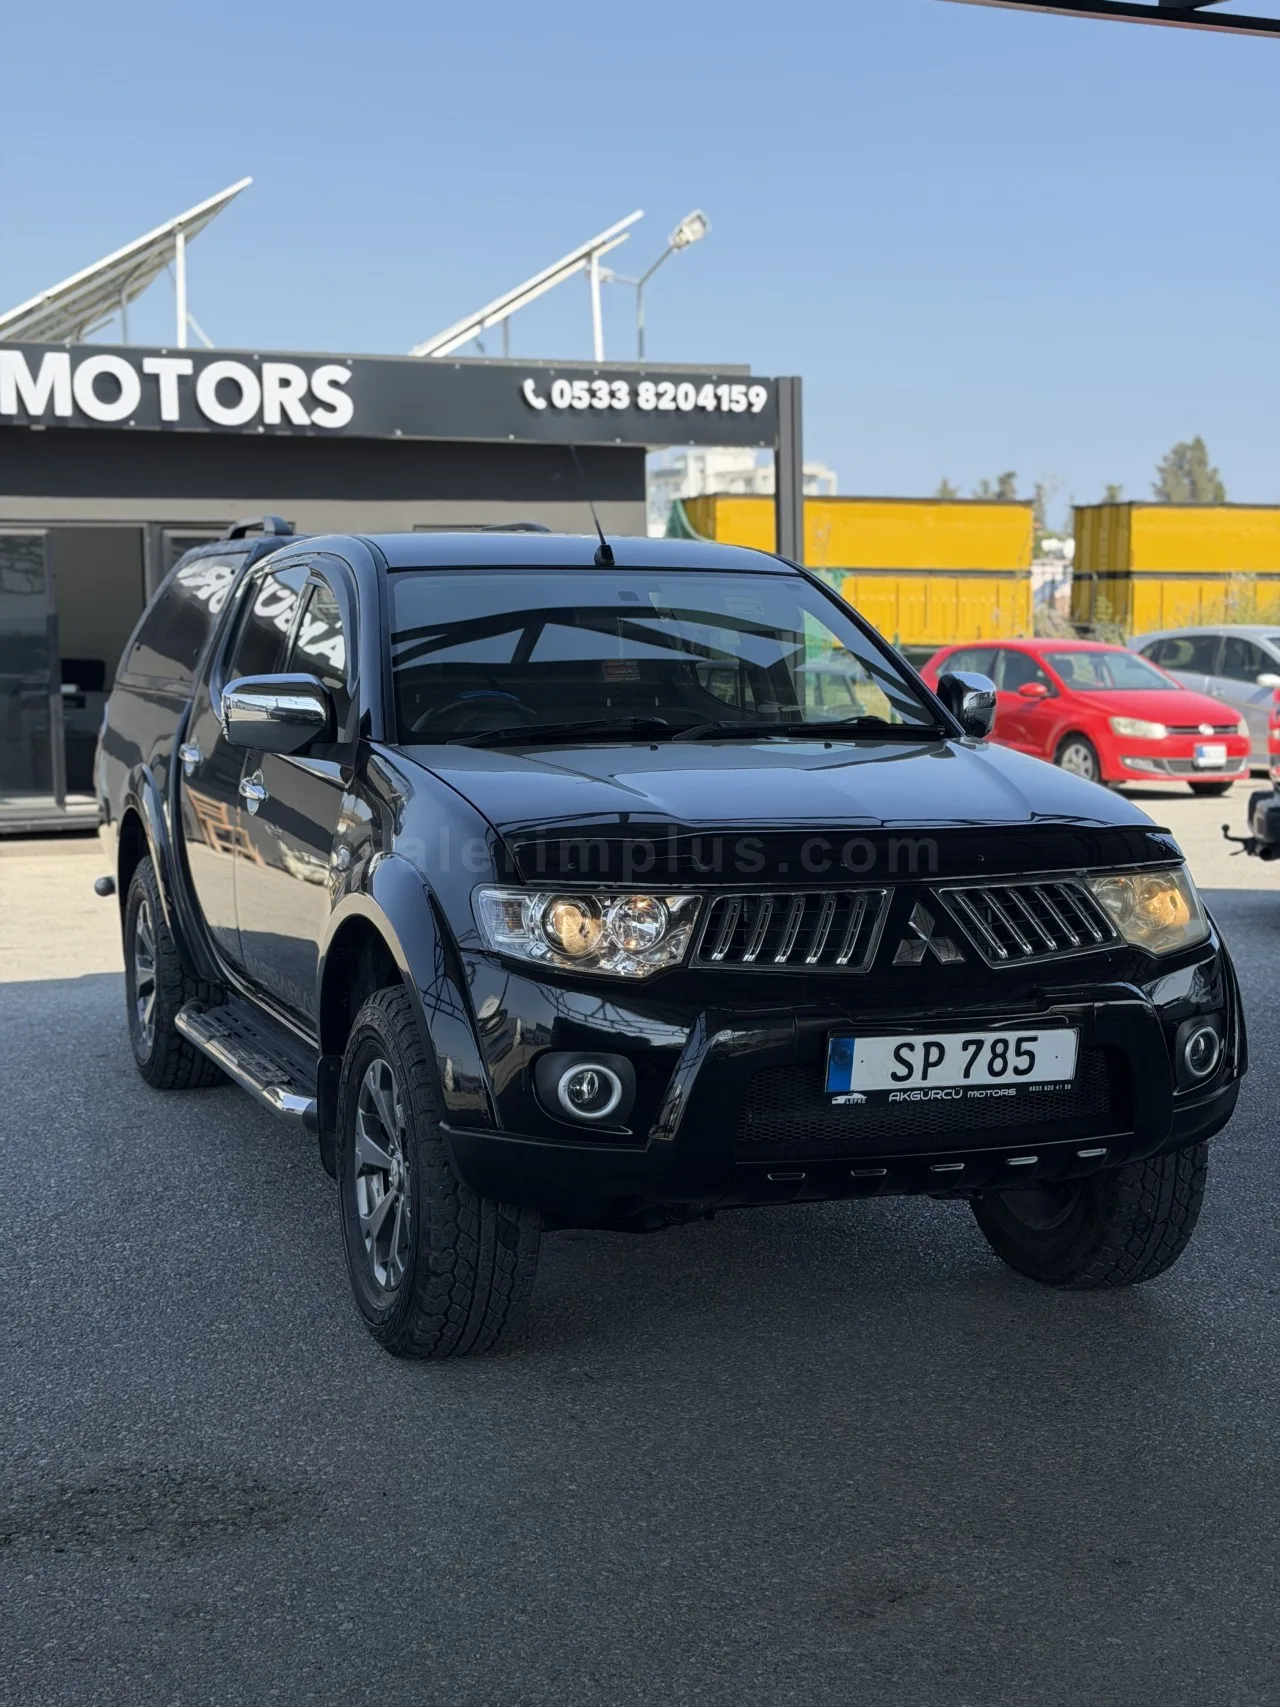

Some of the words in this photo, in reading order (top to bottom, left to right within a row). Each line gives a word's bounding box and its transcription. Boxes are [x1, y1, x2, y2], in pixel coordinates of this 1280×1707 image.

[0, 350, 354, 428] MOTORS
[551, 379, 630, 410] 0533
[637, 381, 768, 413] 8204159
[890, 1041, 946, 1082] SP
[961, 1036, 1039, 1079] 785
[888, 1087, 963, 1102] AKGÜRCÜ
[967, 1088, 1017, 1098] MOTORS
